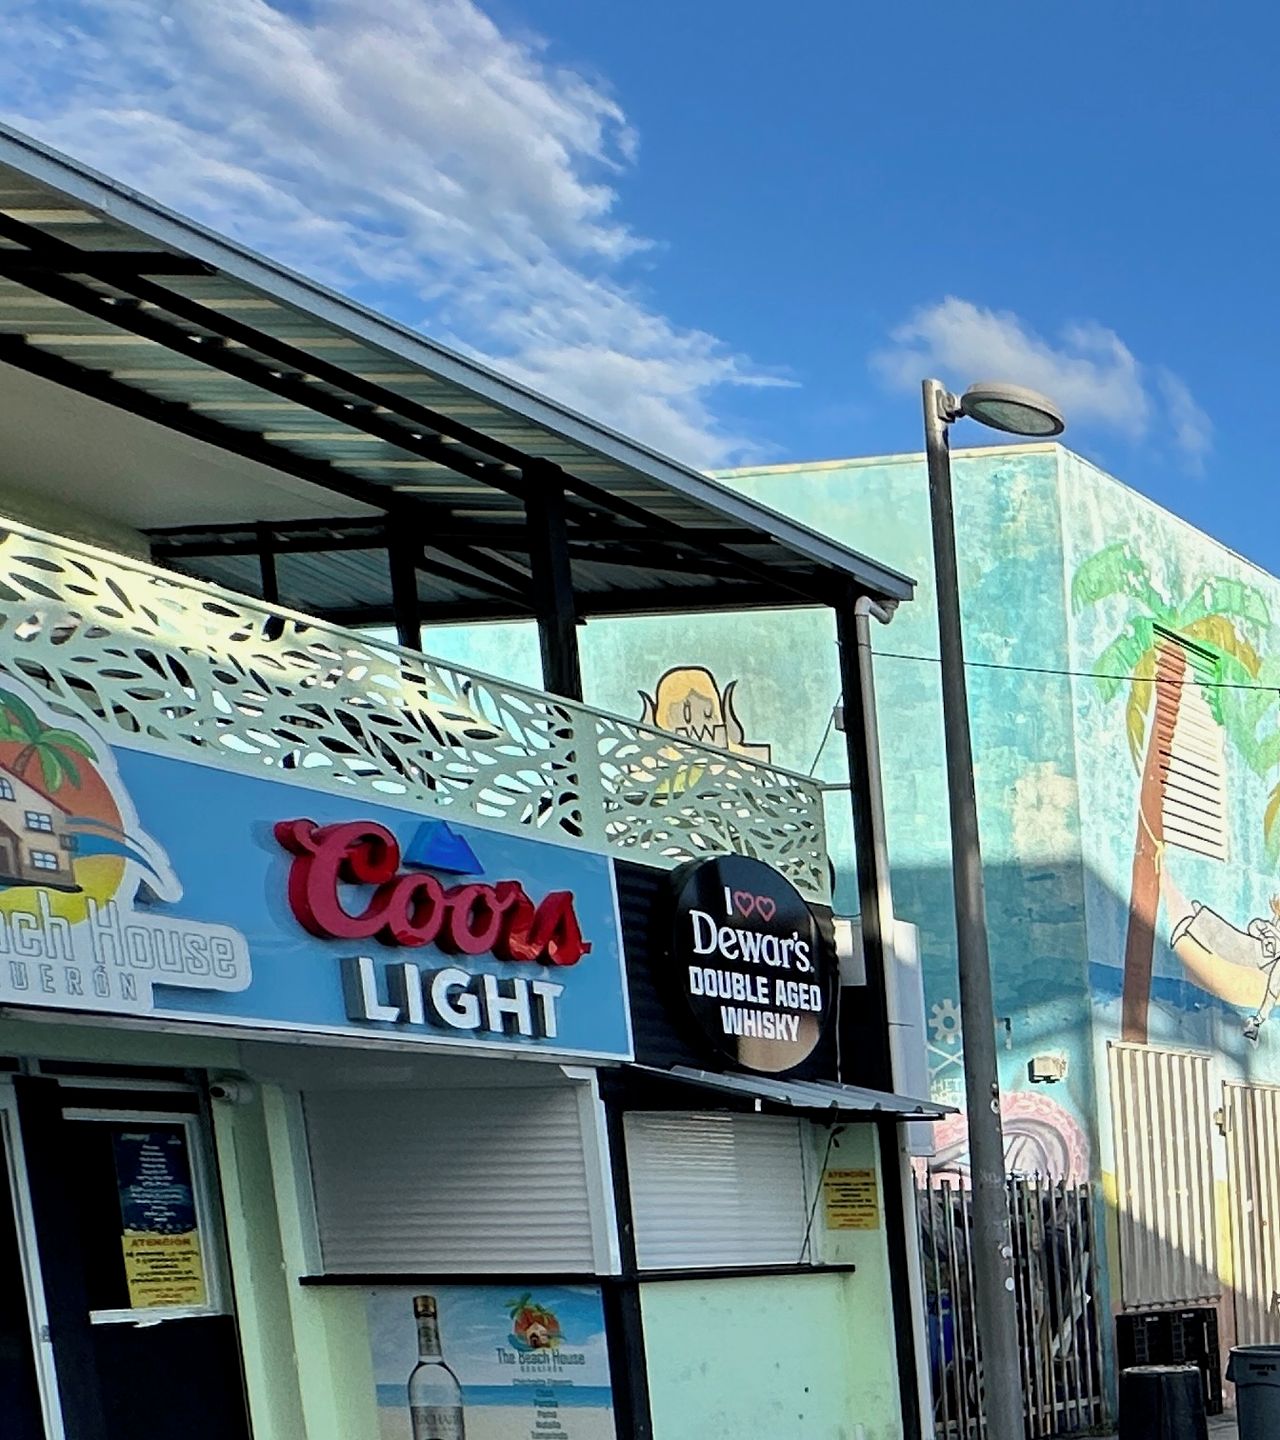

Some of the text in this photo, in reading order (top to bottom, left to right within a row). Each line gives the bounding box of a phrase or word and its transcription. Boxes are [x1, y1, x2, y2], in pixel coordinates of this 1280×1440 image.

[273, 818, 592, 966] Coors
[724, 886, 734, 916] I
[85, 896, 237, 979] House
[689, 909, 812, 973] Dewar's
[341, 956, 565, 1038] LIGHT
[688, 965, 822, 1012] DOUBLE AGED
[720, 1005, 800, 1042] WHISKY
[496, 1347, 586, 1365] The Beach House
